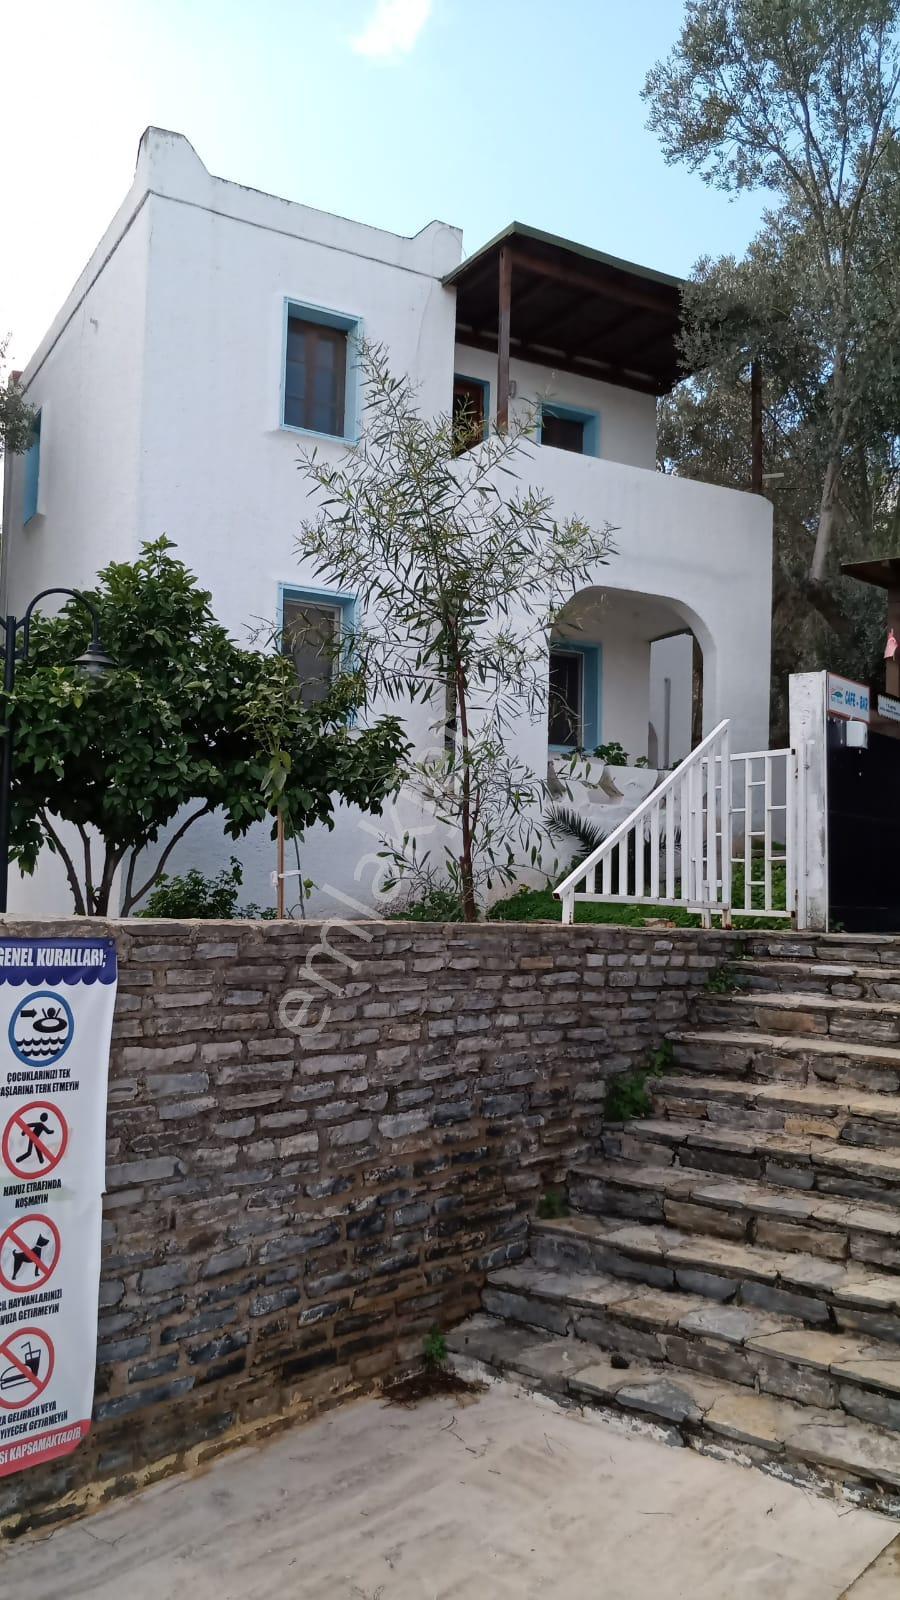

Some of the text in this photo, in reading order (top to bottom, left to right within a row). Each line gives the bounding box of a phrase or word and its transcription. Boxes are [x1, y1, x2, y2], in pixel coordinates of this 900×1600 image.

[7, 1068, 71, 1085] ÇOCUKLARINIZI TEK
[0, 1084, 34, 1098] AŞLARINA
[35, 1083, 52, 1093] TERK
[3, 1179, 62, 1196] HAVUZ ETRAFINDA
[15, 1193, 49, 1208] KOŞMAYIN
[8, 1288, 63, 1309] HAYVANLARINIZI
[41, 1400, 57, 1414] VEYA
